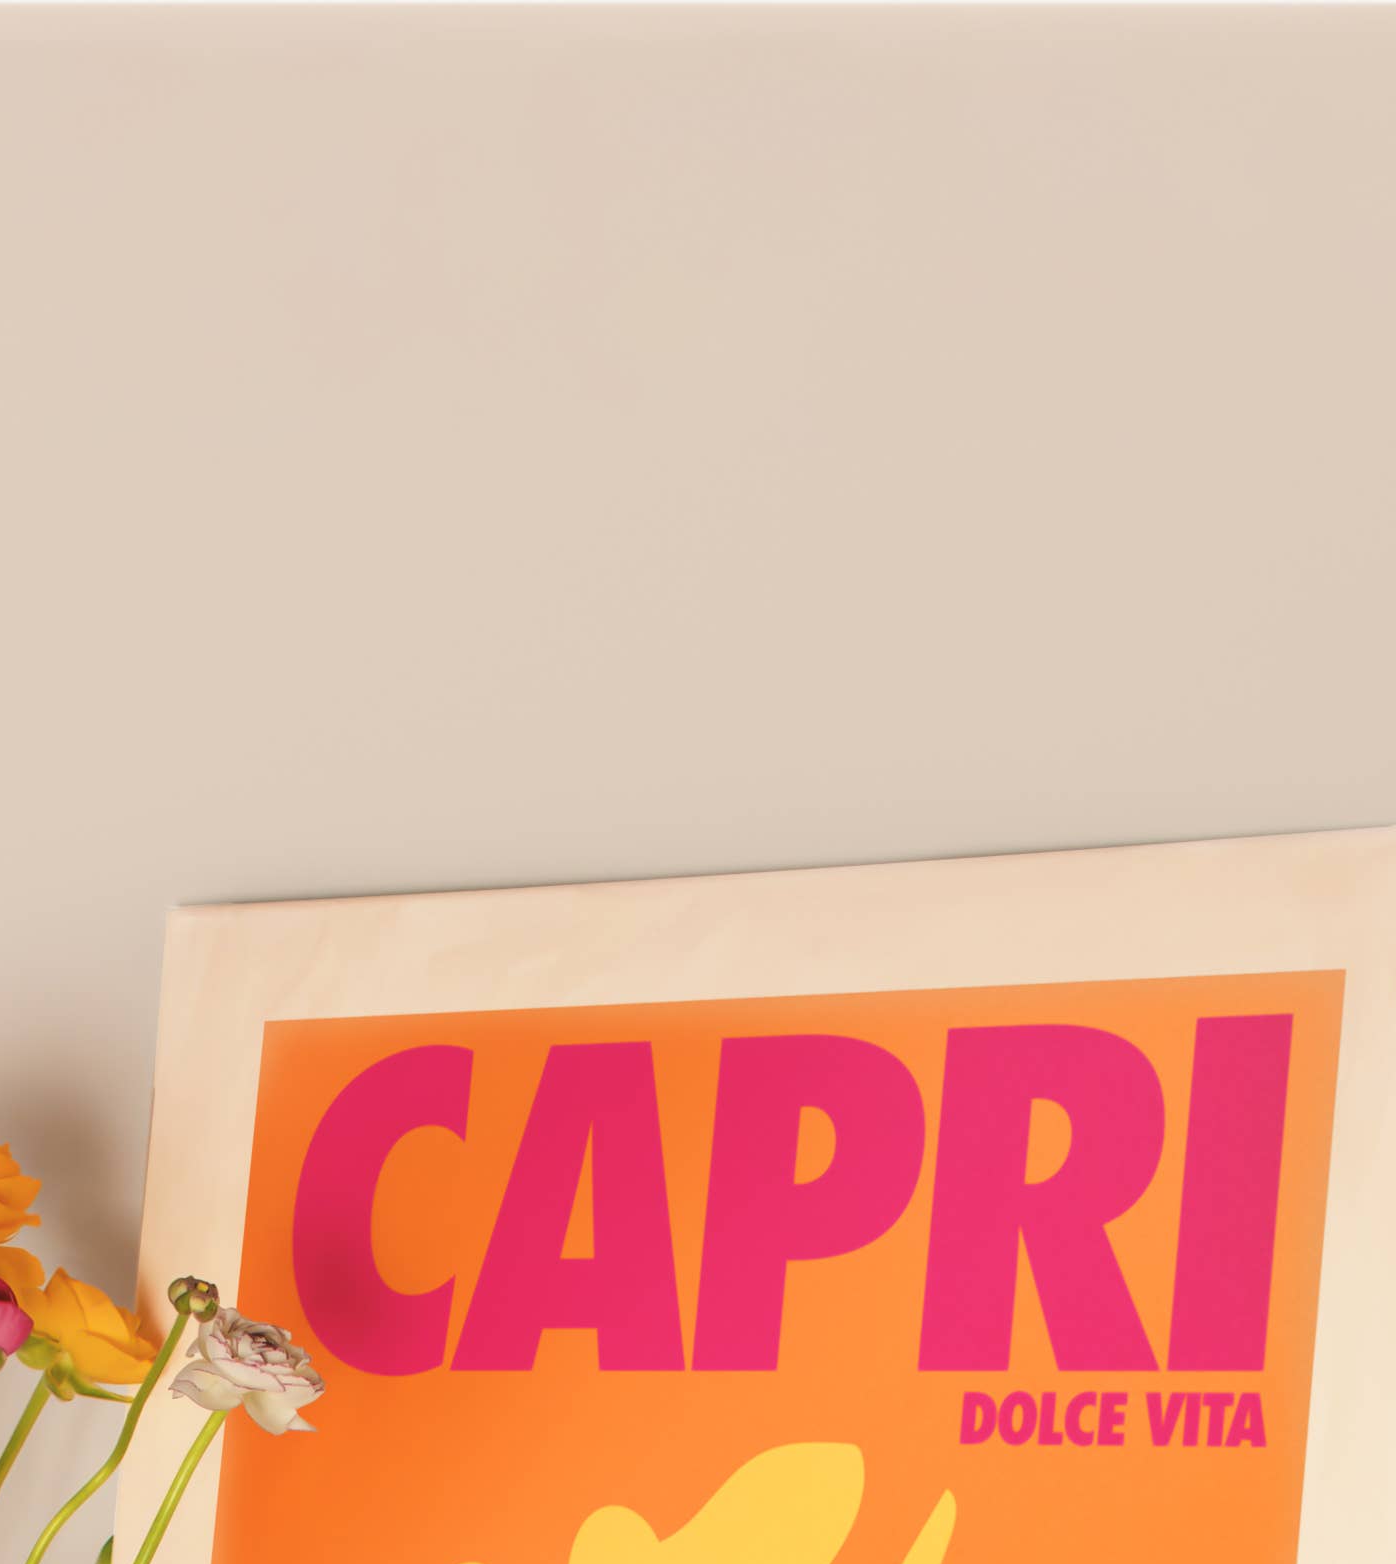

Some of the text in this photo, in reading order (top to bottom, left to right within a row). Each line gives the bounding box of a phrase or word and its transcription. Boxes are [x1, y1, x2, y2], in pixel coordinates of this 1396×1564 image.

[292, 1013, 1294, 1377] CAPRI
[959, 1390, 1267, 1447] DOLCE VITA
